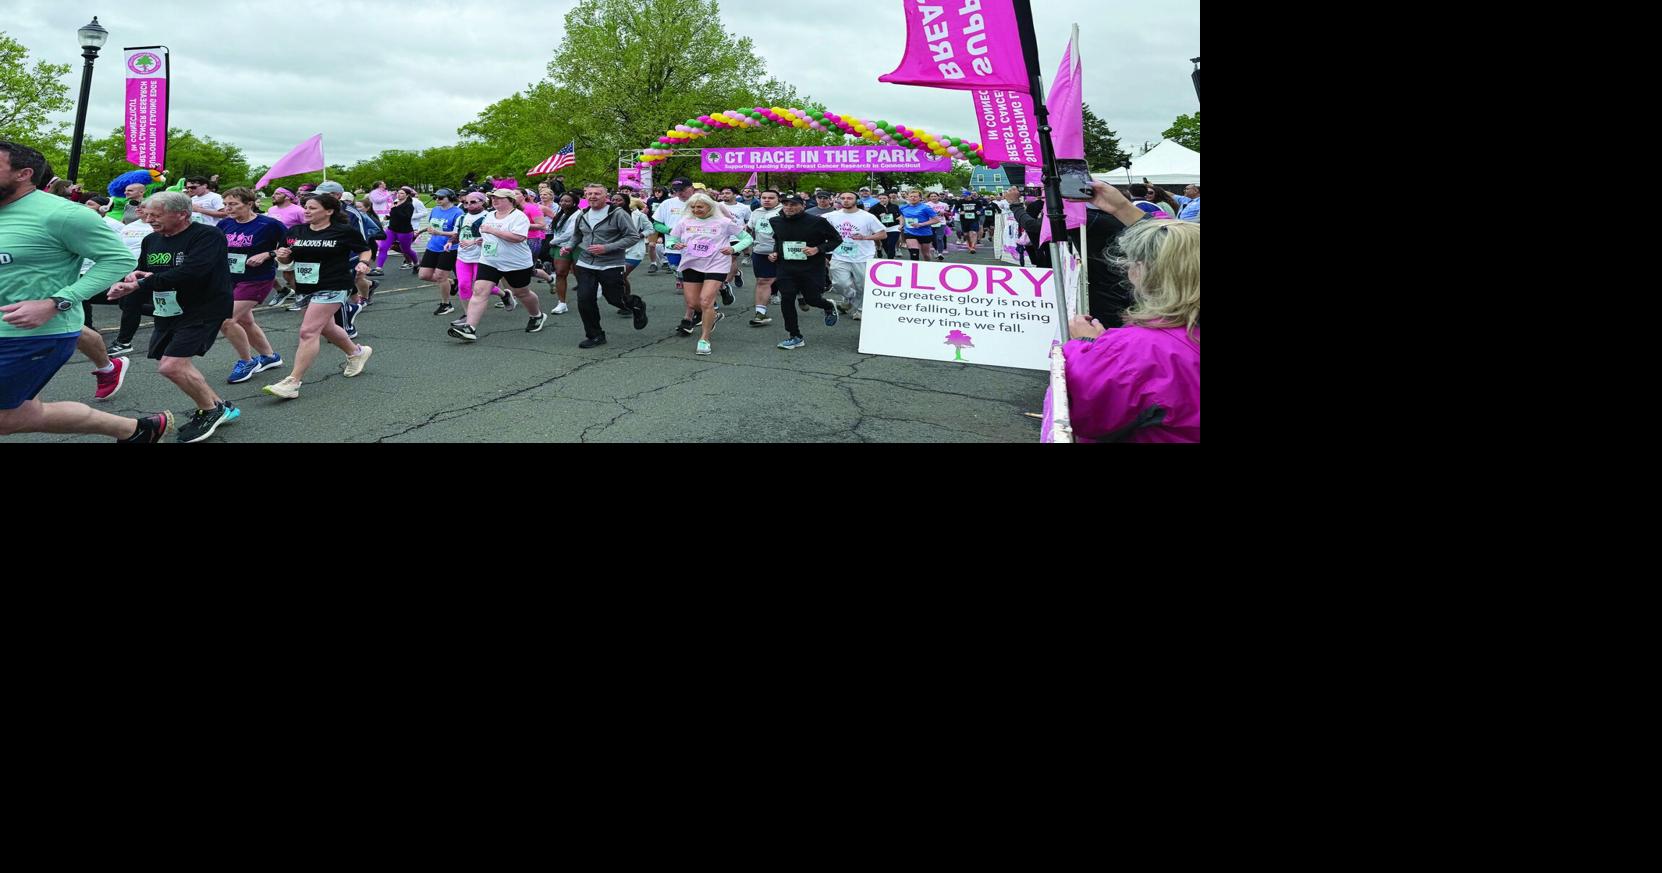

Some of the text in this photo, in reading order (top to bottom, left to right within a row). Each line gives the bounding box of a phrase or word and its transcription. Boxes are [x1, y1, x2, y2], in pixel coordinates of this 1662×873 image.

[724, 149, 920, 163] CT RACE IN THE PARK
[870, 260, 1054, 297] GLORY
[872, 288, 1054, 309] Our greatest glory is not in
[875, 302, 1050, 323] never falling, but in rising
[898, 315, 1024, 333] every time we fall.
